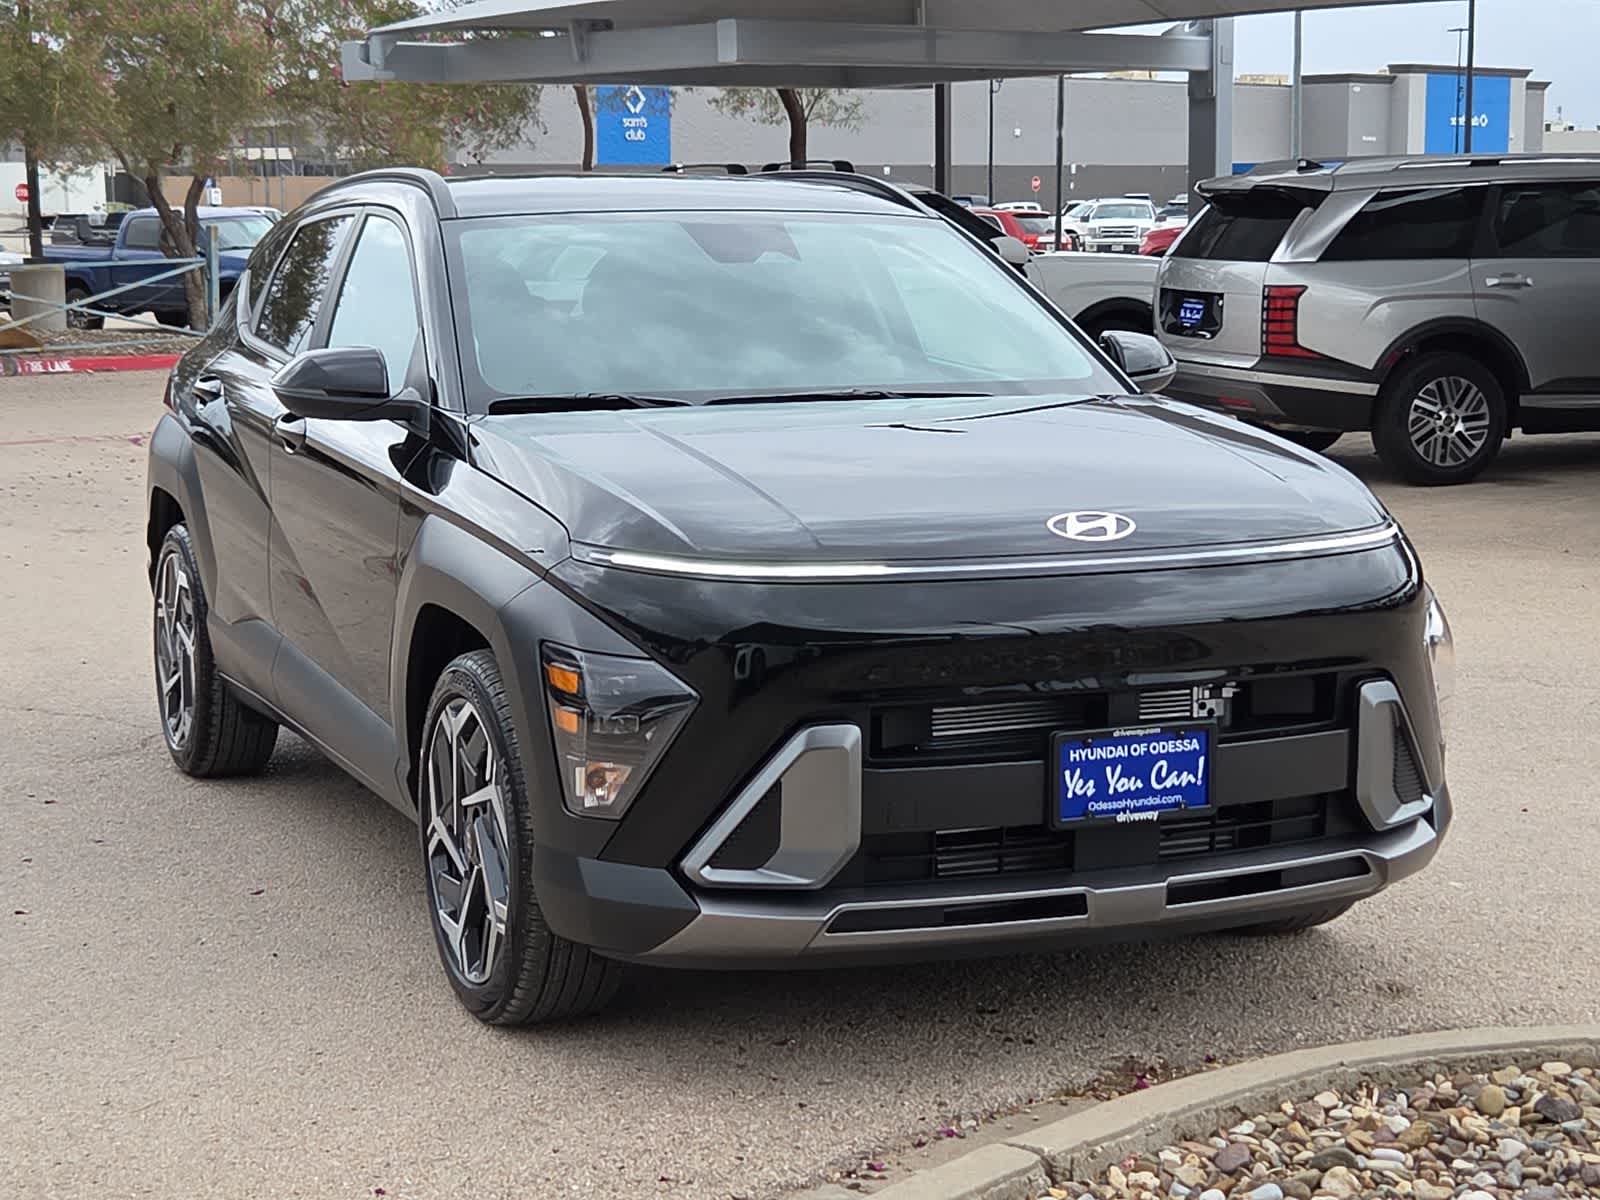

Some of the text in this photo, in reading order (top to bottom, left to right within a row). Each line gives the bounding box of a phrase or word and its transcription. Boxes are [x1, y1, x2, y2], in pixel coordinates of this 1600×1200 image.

[625, 129, 646, 141] club
[48, 360, 74, 373] LANE
[1069, 738, 1200, 762] HYUNDAI OF ODESSA
[1064, 755, 1205, 799] Yes You Can!
[1088, 794, 1183, 811] OdessaHyundai.com
[1116, 809, 1159, 823] driveway
